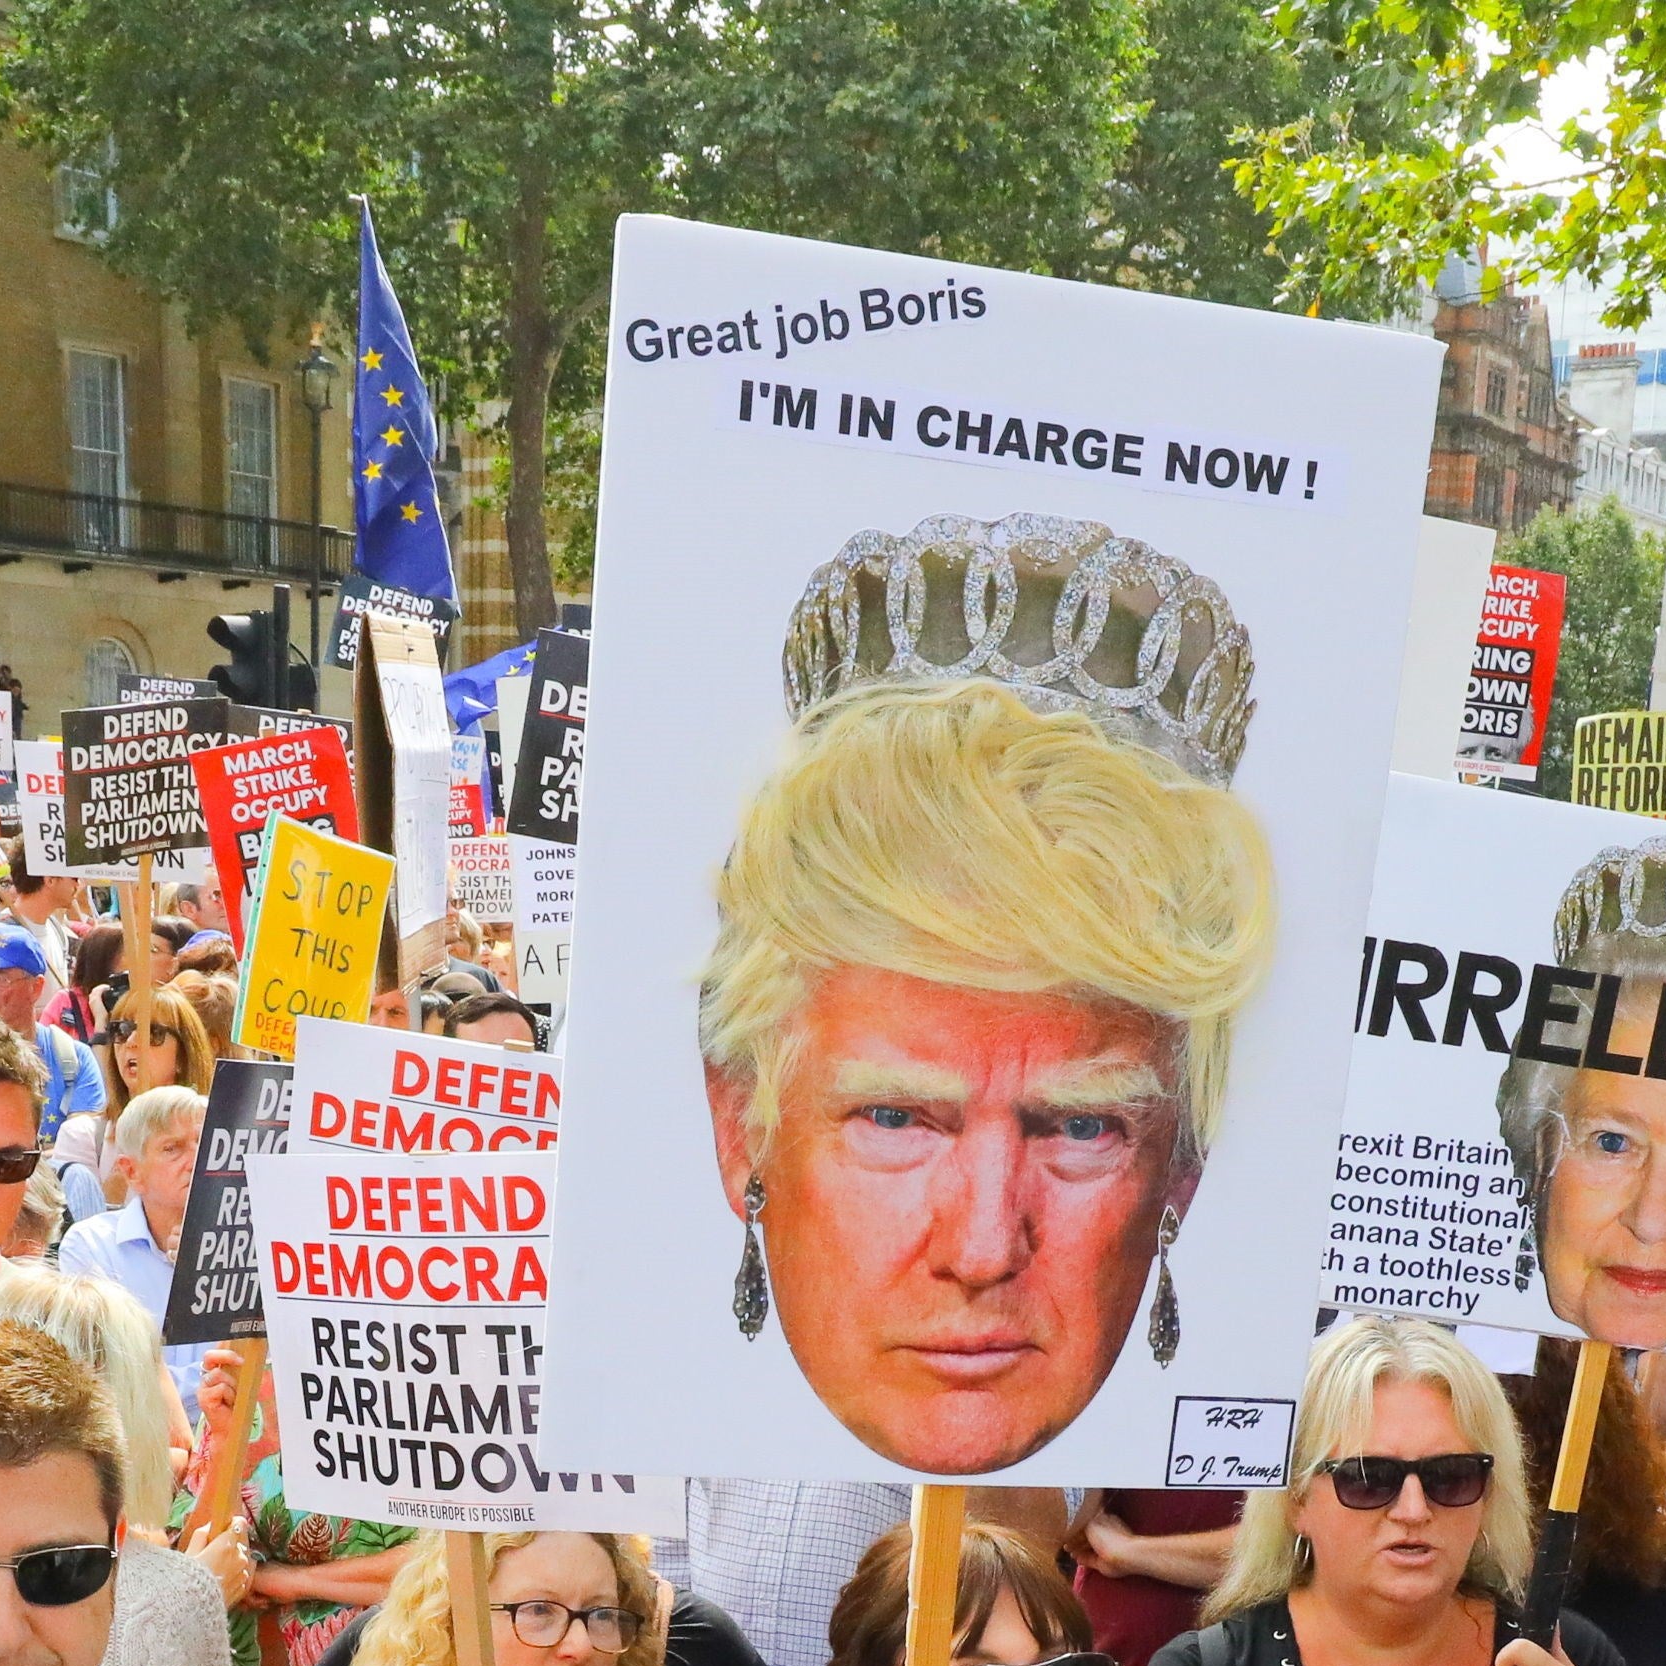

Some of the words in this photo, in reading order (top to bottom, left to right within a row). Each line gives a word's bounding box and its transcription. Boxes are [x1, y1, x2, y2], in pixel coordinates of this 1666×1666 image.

[626, 310, 761, 364] Great
[774, 298, 851, 360] job
[858, 279, 987, 334] Boris
[738, 379, 818, 431] I'M
[838, 393, 895, 441] IN
[914, 404, 1144, 477] CHARGE
[1165, 444, 1290, 495] NOW
[370, 584, 434, 616] DEFEND
[140, 678, 195, 694] DEFEND
[103, 708, 189, 740] DEFEND
[71, 733, 224, 771] DEMOCRACY
[223, 740, 317, 776] MARCH,
[91, 772, 155, 800] RESIST
[233, 764, 318, 798] STRIKE,
[231, 786, 327, 823] OCCUPY
[283, 860, 373, 917] STOP
[289, 928, 353, 973] THIS
[265, 978, 346, 1021] COUP
[1412, 1136, 1509, 1166] Britain
[1336, 1157, 1479, 1198] becoming
[1489, 1176, 1523, 1196] an
[326, 1176, 545, 1233] DEFEND
[1331, 1192, 1528, 1229] constitutional
[1330, 1222, 1418, 1247] anana
[1429, 1227, 1512, 1257] State'
[1353, 1256, 1369, 1273] a
[1380, 1253, 1510, 1286] toothless
[1334, 1284, 1479, 1316] monarchy
[313, 1317, 466, 1375] RESIST
[1205, 1407, 1263, 1430] HRH
[1175, 1454, 1194, 1475] D
[1223, 1456, 1283, 1482] Trump
[388, 1501, 428, 1519] ANOTHER
[430, 1505, 464, 1520] EUROPE
[467, 1507, 475, 1521] IS
[481, 1506, 537, 1523] POSSIBLE
